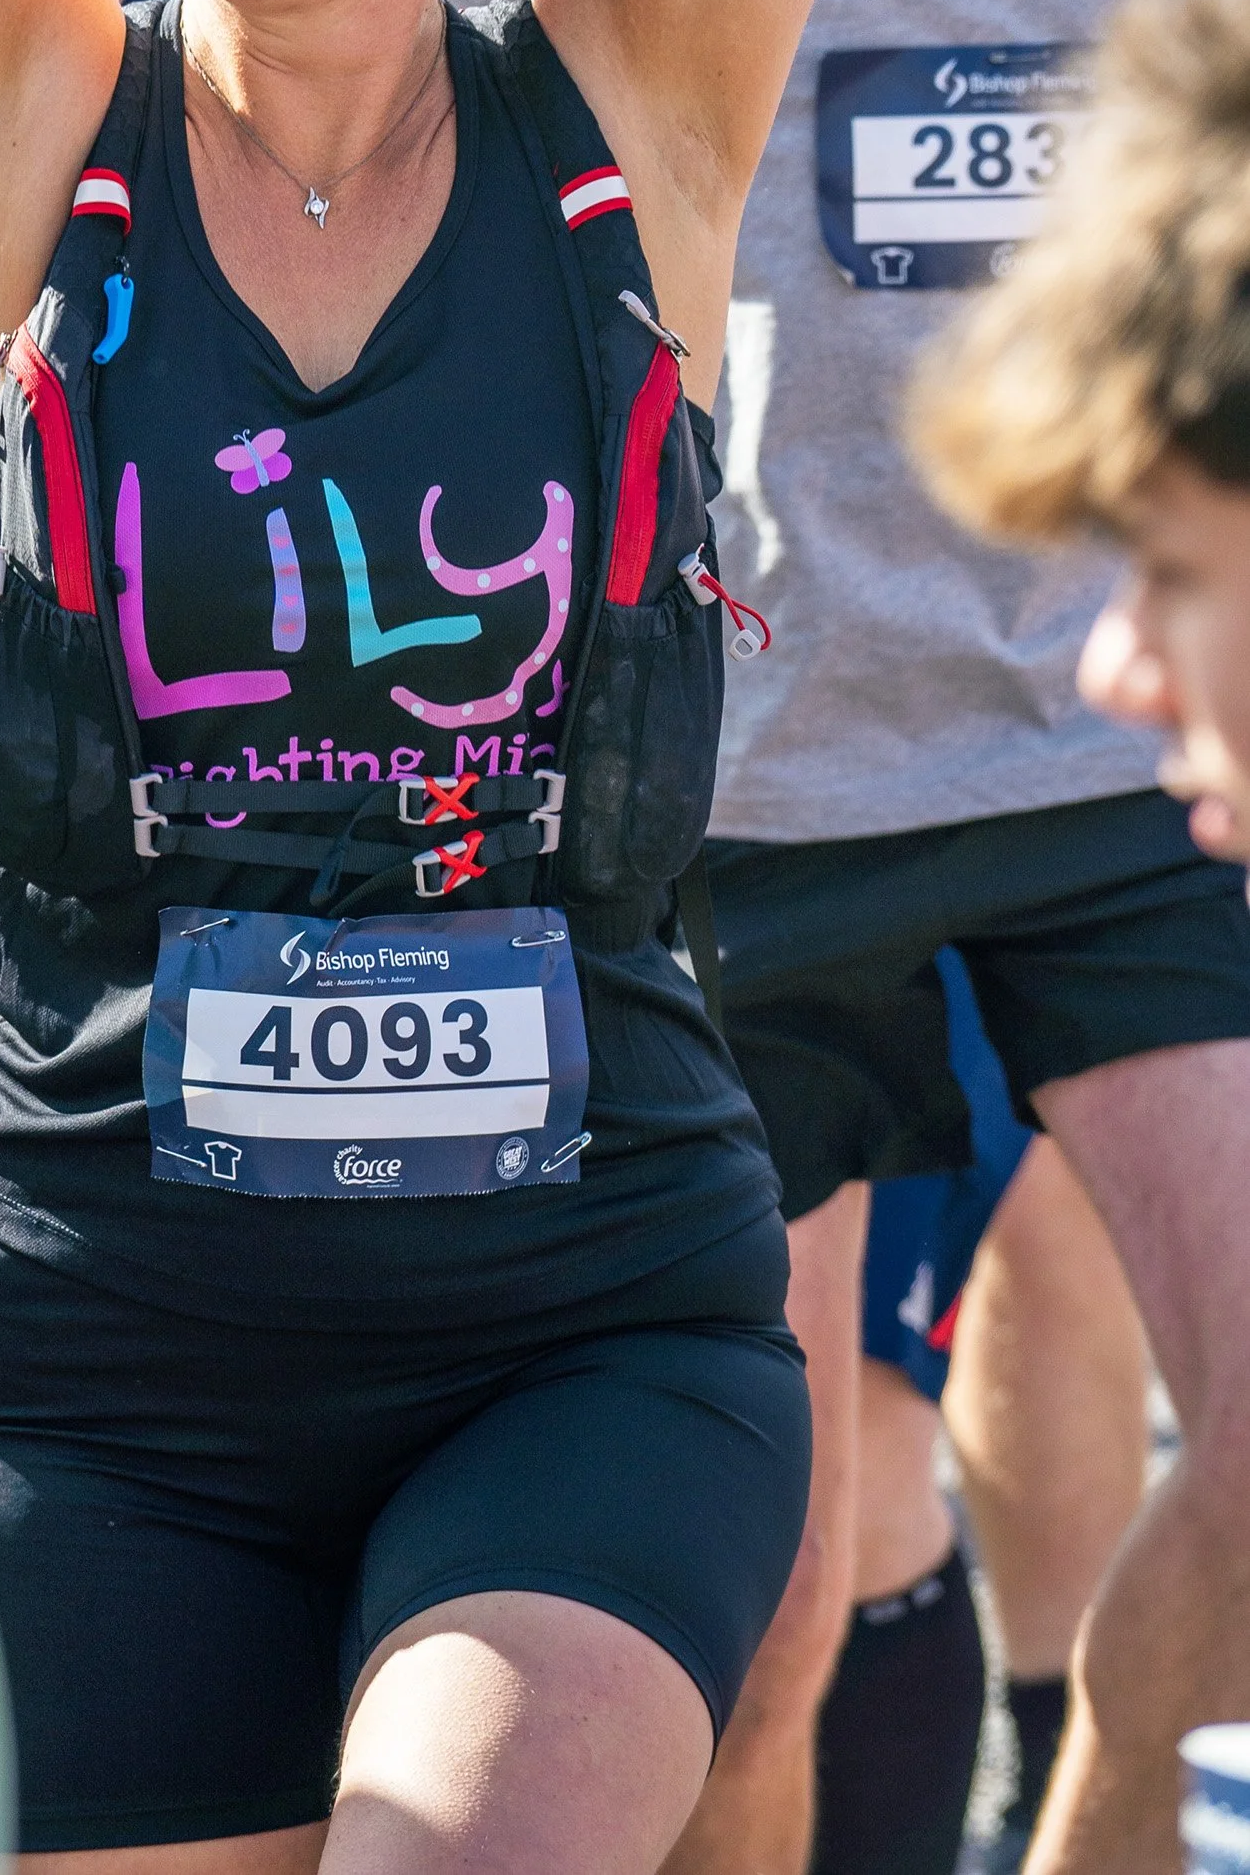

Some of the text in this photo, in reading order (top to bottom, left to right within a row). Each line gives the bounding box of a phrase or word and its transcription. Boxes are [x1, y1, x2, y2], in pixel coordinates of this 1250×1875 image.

[912, 122, 1066, 190] 283
[455, 733, 556, 777] Mi
[316, 946, 450, 973] Bishop Fleming
[316, 979, 333, 987] Audit
[337, 978, 374, 987] Accountancy
[391, 976, 416, 984] Advisory
[240, 998, 492, 1081] 4093
[333, 1144, 363, 1185] cancer charity
[343, 1155, 402, 1177] force
